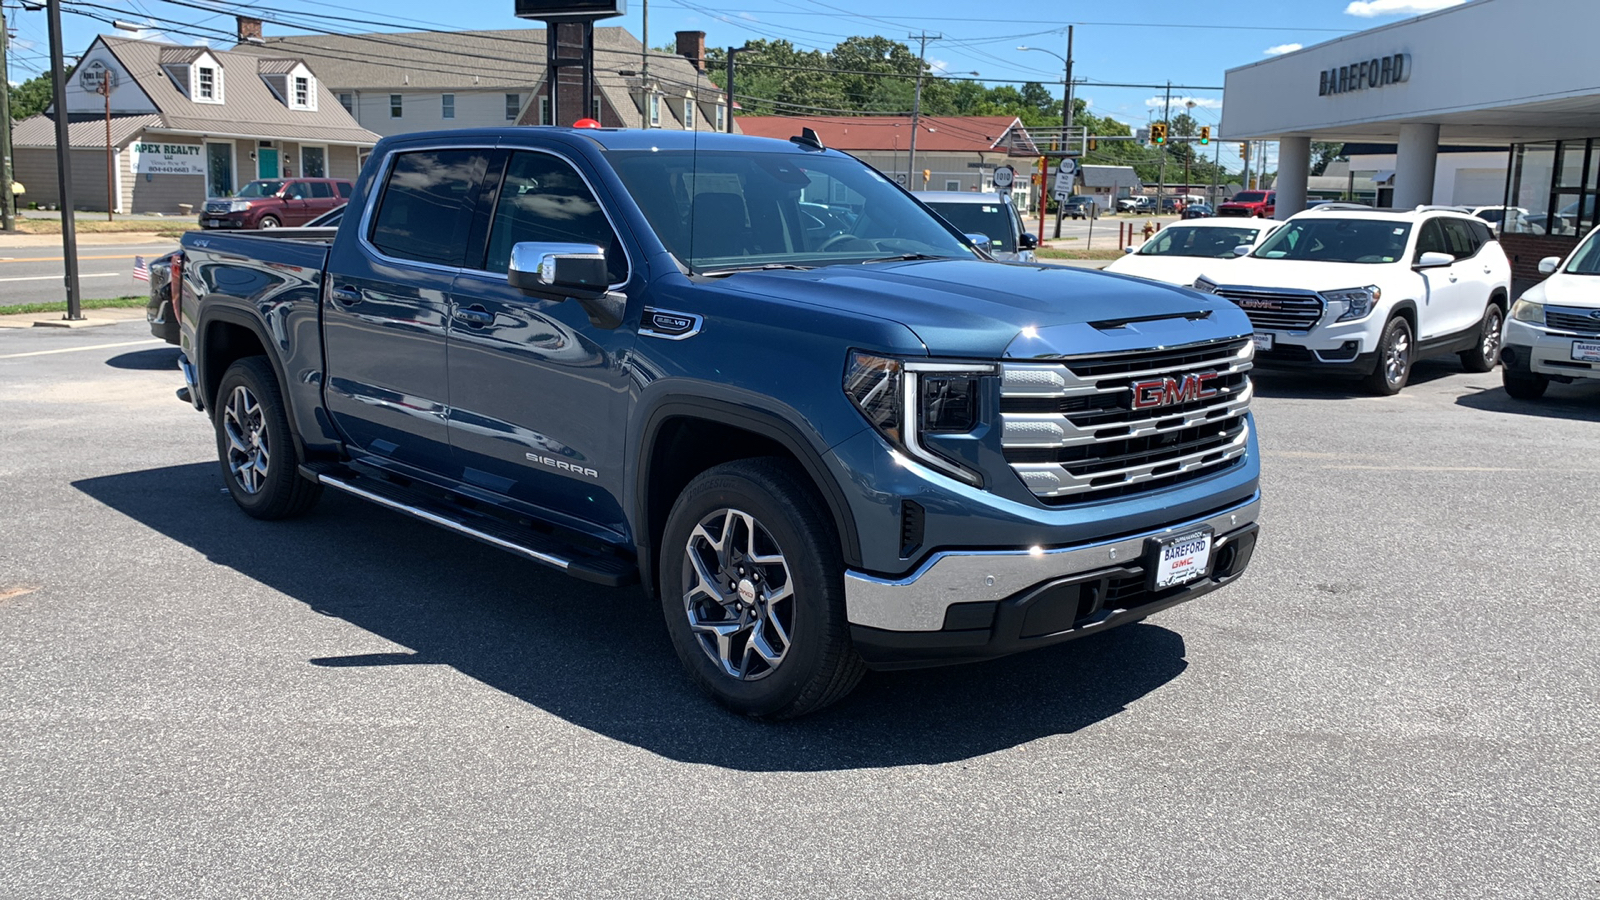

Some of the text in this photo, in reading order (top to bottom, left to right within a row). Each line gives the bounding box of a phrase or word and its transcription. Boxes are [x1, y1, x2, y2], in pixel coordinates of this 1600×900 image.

[1319, 53, 1411, 97] BAREFORD
[134, 143, 200, 155] APEX REALTY
[996, 172, 1011, 181] 1010
[1239, 298, 1282, 309] GMC
[1132, 369, 1218, 410] GMC
[525, 452, 598, 478] SIERRA
[1164, 540, 1206, 561] BAREFORD
[1171, 556, 1194, 569] GMC
